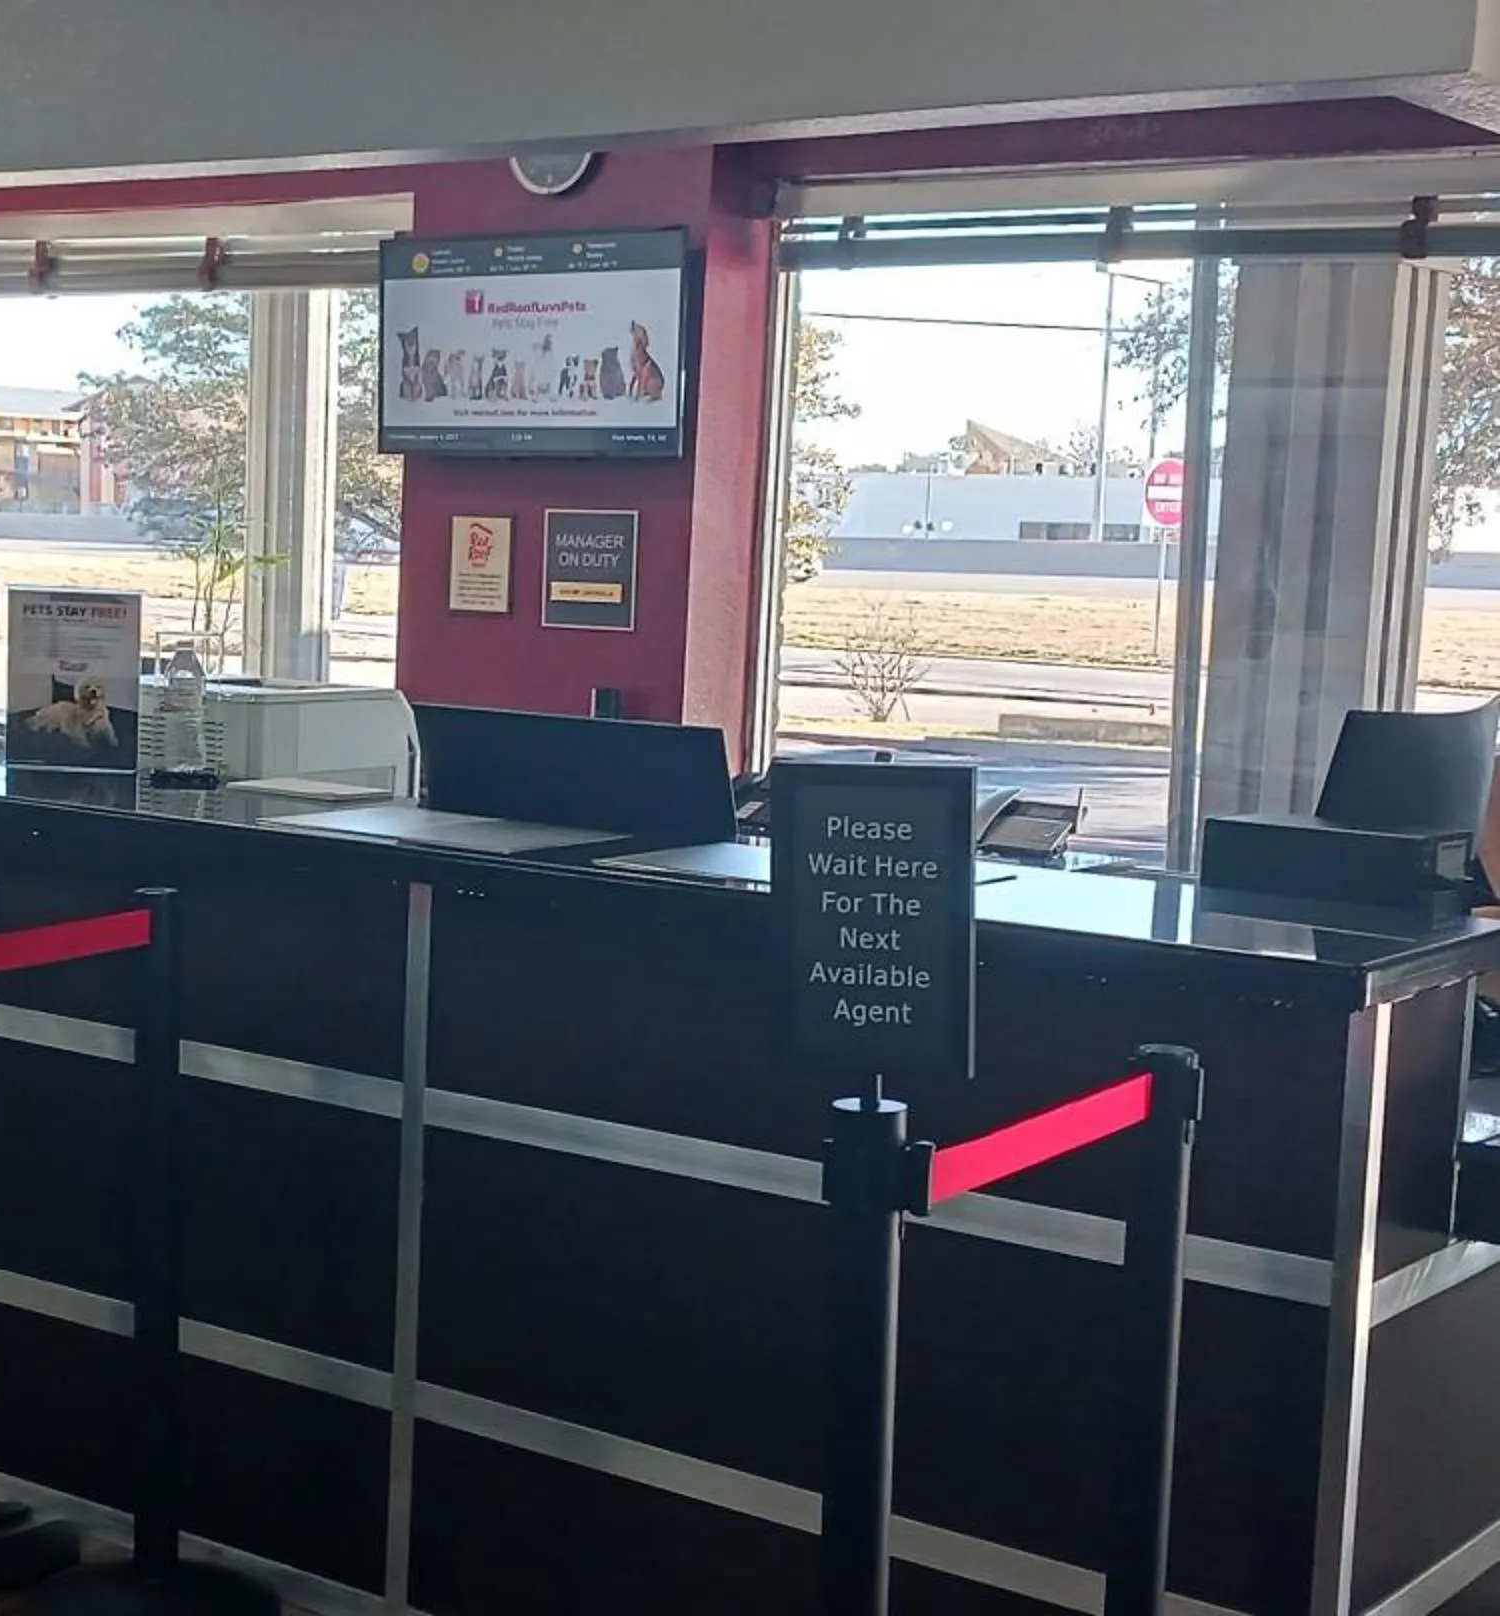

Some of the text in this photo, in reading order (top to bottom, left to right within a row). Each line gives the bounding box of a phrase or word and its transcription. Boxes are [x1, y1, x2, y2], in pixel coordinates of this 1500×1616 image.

[555, 533, 625, 550] MANAGER
[559, 551, 620, 569] ON DUTY
[22, 603, 128, 619] PETS STAY FREE!
[826, 815, 912, 841] Please
[808, 853, 939, 880] Wait Here
[821, 891, 921, 917] For The
[840, 927, 901, 951] Next
[809, 961, 931, 989] Available
[833, 998, 912, 1027] Agent
